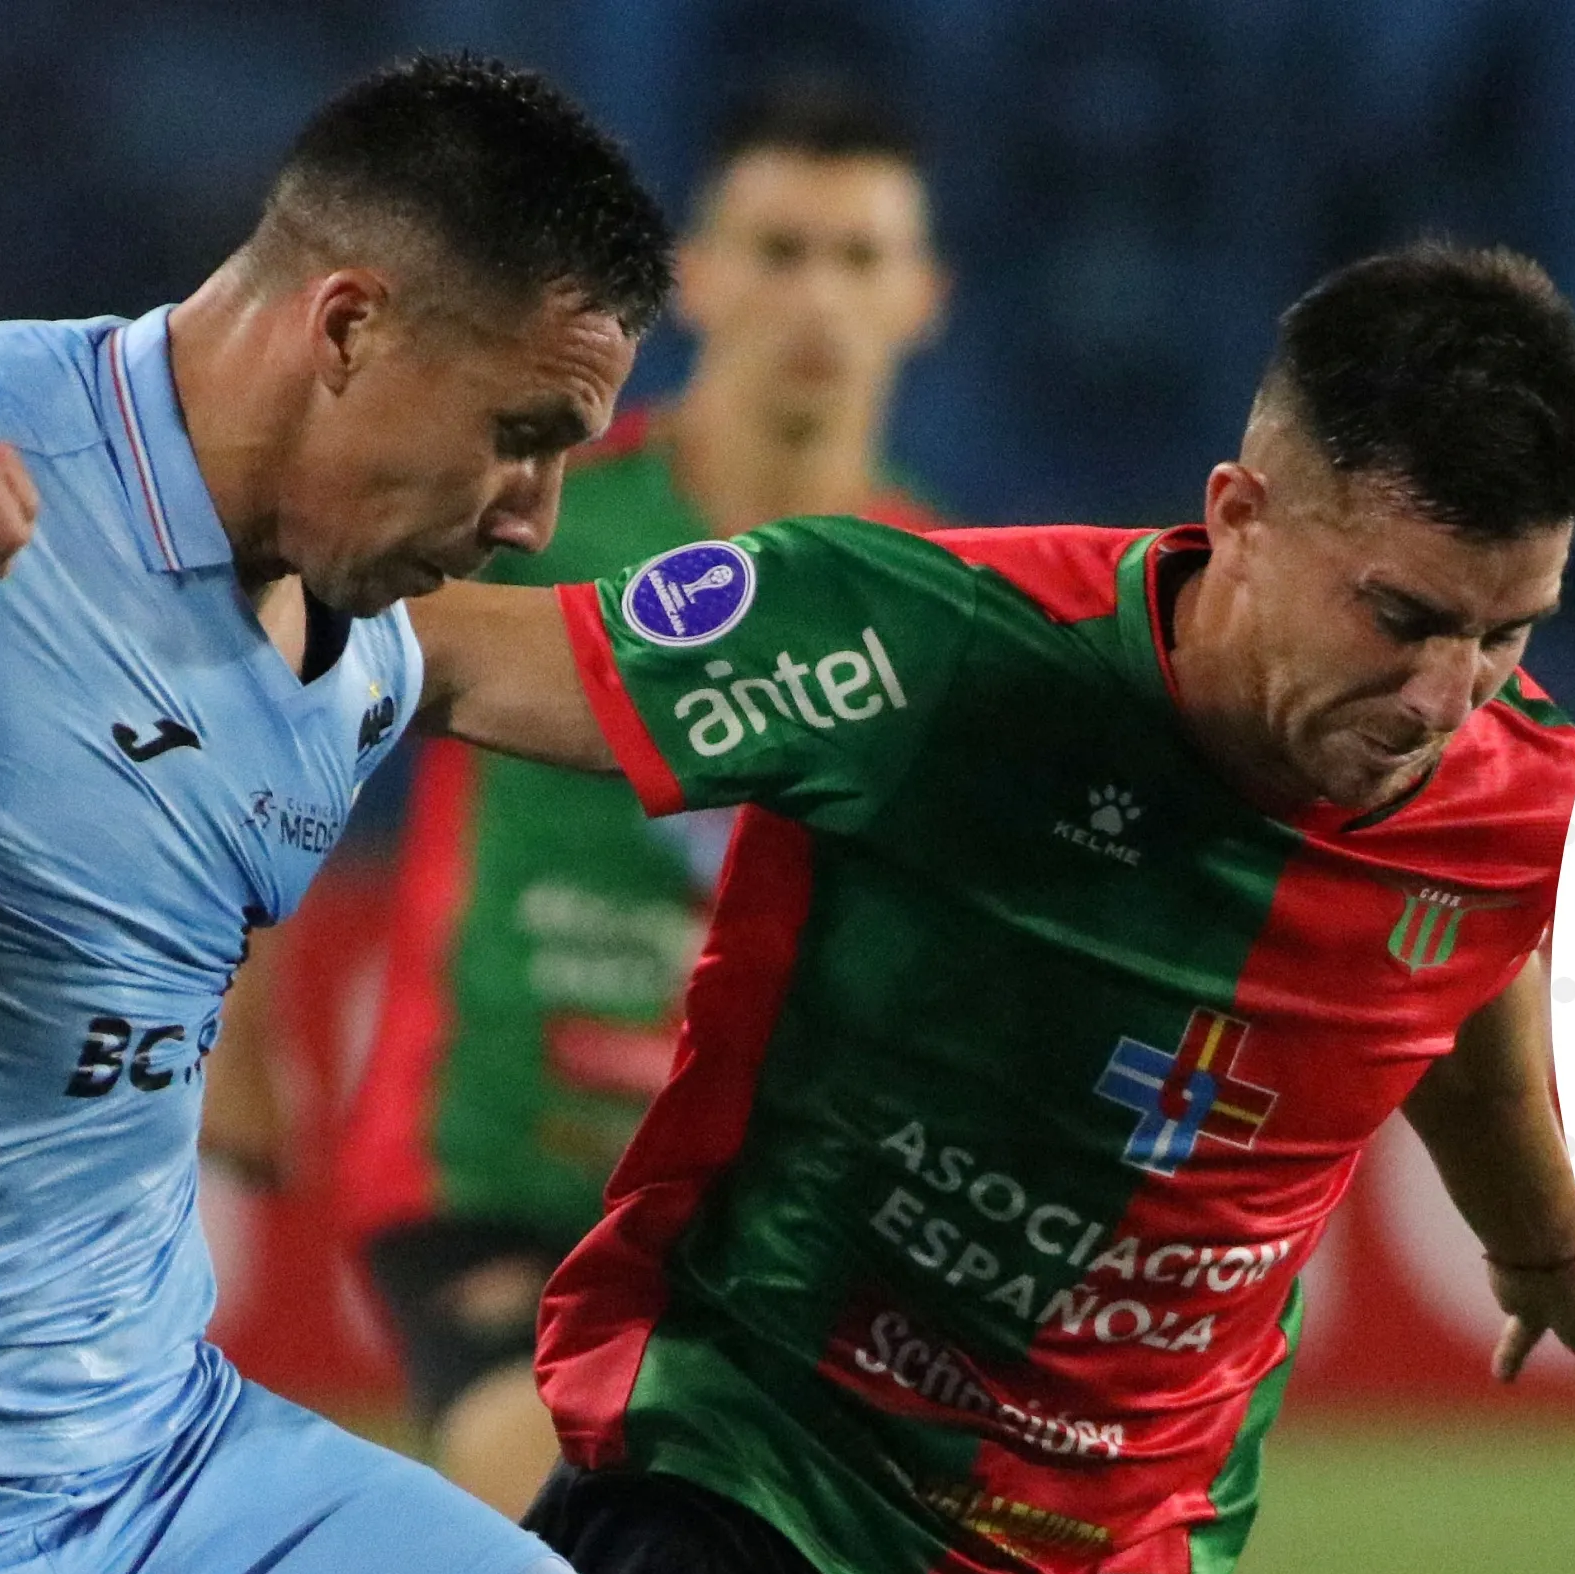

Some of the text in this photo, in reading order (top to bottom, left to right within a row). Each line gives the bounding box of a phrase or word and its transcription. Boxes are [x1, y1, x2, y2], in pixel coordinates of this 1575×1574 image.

[673, 625, 908, 757] antel
[1053, 821, 1141, 867] KELME
[869, 1186, 1216, 1354] ESPAÑOLA
